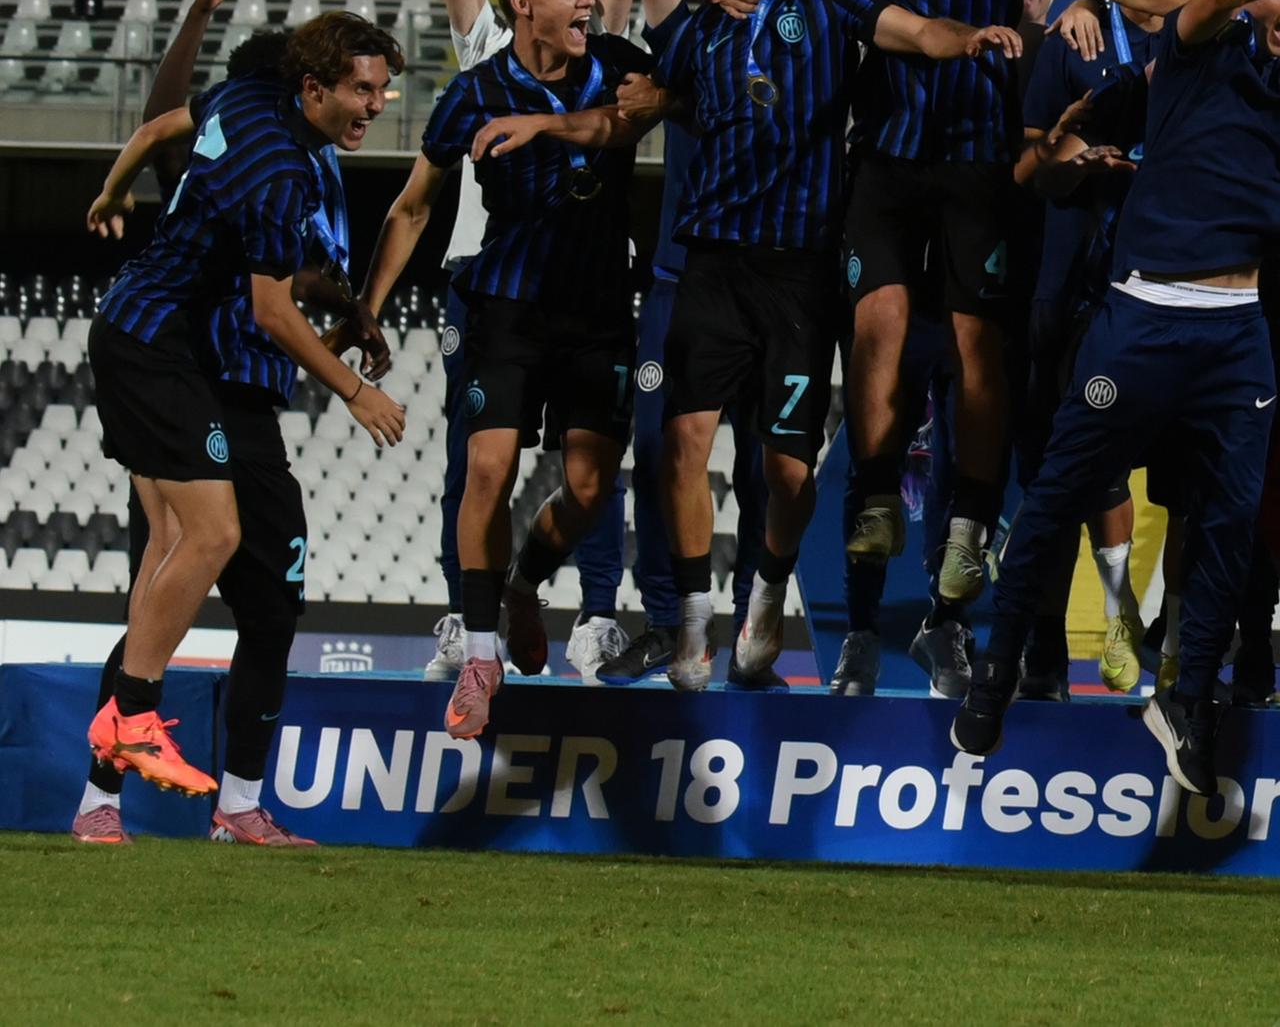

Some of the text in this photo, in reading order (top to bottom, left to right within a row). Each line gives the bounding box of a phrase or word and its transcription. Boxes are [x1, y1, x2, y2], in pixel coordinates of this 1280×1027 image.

[783, 374, 811, 420] 7
[273, 725, 618, 820] UNDER
[650, 738, 745, 825] 18
